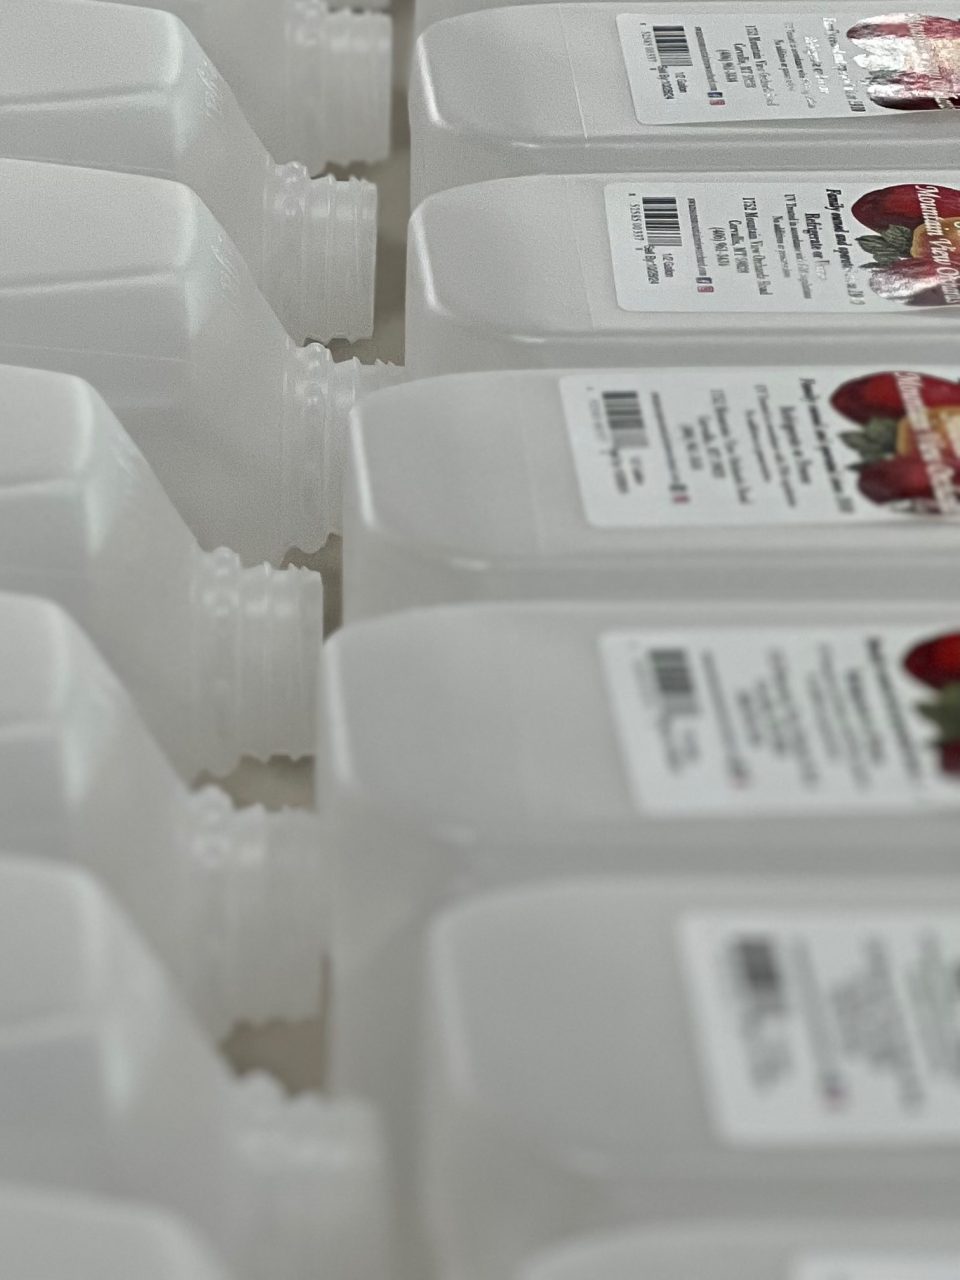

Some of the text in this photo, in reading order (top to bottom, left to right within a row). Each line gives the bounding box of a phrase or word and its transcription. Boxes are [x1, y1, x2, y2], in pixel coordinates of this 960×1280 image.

[747, 37, 766, 59] Mountain
[742, 197, 756, 211] 1752
[783, 194, 796, 202] UV
[825, 189, 844, 211] Family
[914, 185, 948, 235] Mountain
[727, 220, 744, 245] Corvallis,
[744, 212, 762, 239] Mountain
[804, 213, 824, 249] Refrigerate
[830, 213, 848, 232] owned
[709, 227, 727, 241] (406)
[835, 234, 852, 245] and
[733, 247, 746, 257] MT
[751, 241, 764, 254] View
[928, 238, 955, 264] View
[662, 253, 676, 278] 1/2 Gallon
